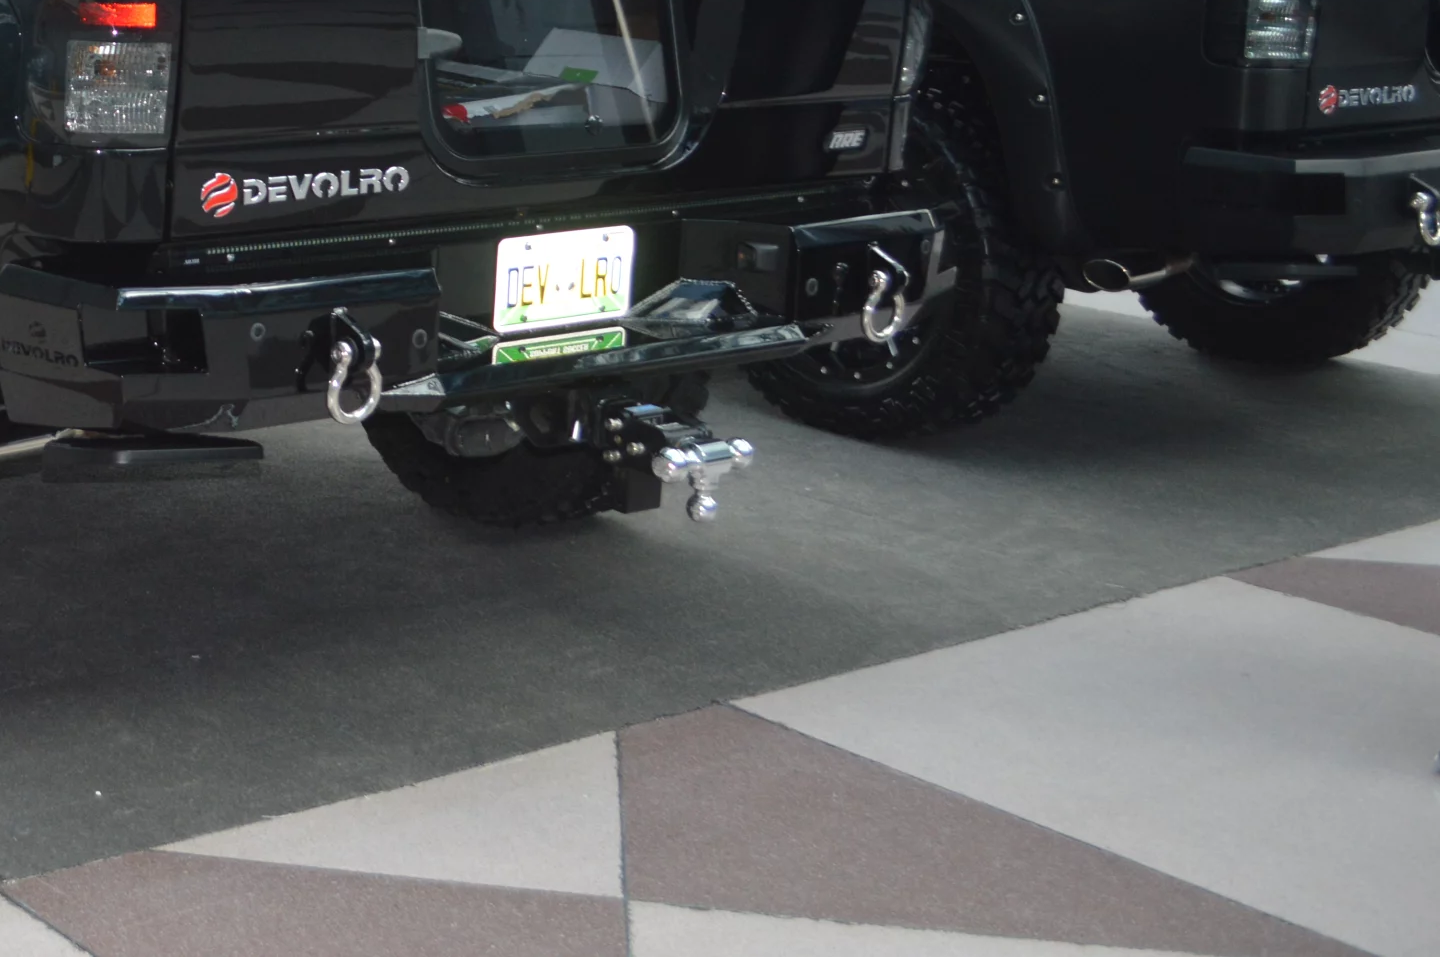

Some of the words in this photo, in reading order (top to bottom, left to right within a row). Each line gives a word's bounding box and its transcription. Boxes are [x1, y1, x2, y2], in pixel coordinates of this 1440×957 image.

[1338, 84, 1416, 107] DEVOLRO
[828, 129, 866, 150] ARE
[242, 164, 411, 207] DEVOLRO
[506, 263, 550, 309] DEV
